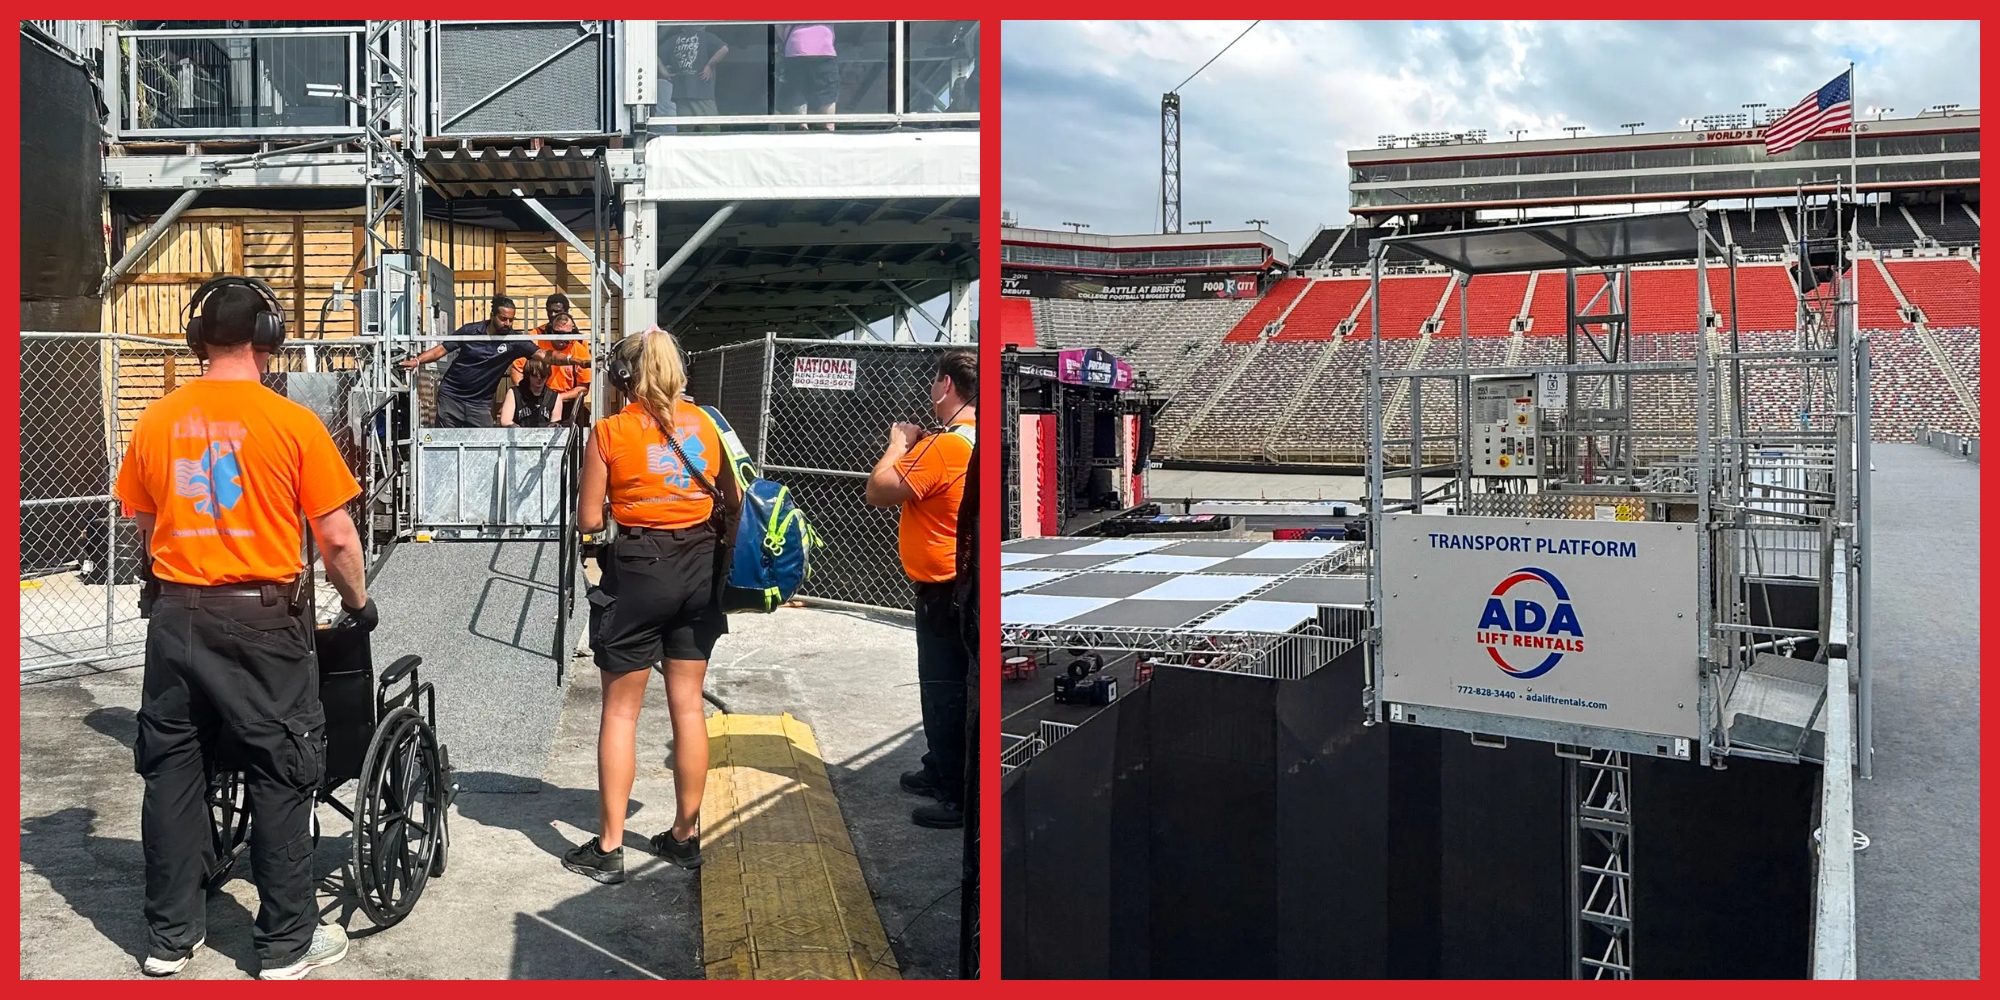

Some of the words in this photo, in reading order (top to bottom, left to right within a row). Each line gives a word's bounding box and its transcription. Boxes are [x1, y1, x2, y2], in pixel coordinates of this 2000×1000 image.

[1707, 130, 1753, 140] WORLD'S
[1005, 280, 1020, 288] TV
[1102, 286, 1137, 294] BATTLE
[1151, 285, 1186, 293] BRISTOL
[1203, 282, 1224, 291] FOOD
[1237, 282, 1255, 290] CITY
[796, 358, 854, 374] NATIONAL
[1428, 533, 1531, 553] TRANSPORT
[1536, 538, 1637, 558] PLATFORM
[1477, 598, 1585, 637] ADA
[1477, 632, 1509, 645] LIFT
[1513, 635, 1584, 652] RENTALS
[1457, 685, 1516, 700] 772-828-3440
[1526, 693, 1608, 710] adaliftrentals.com
